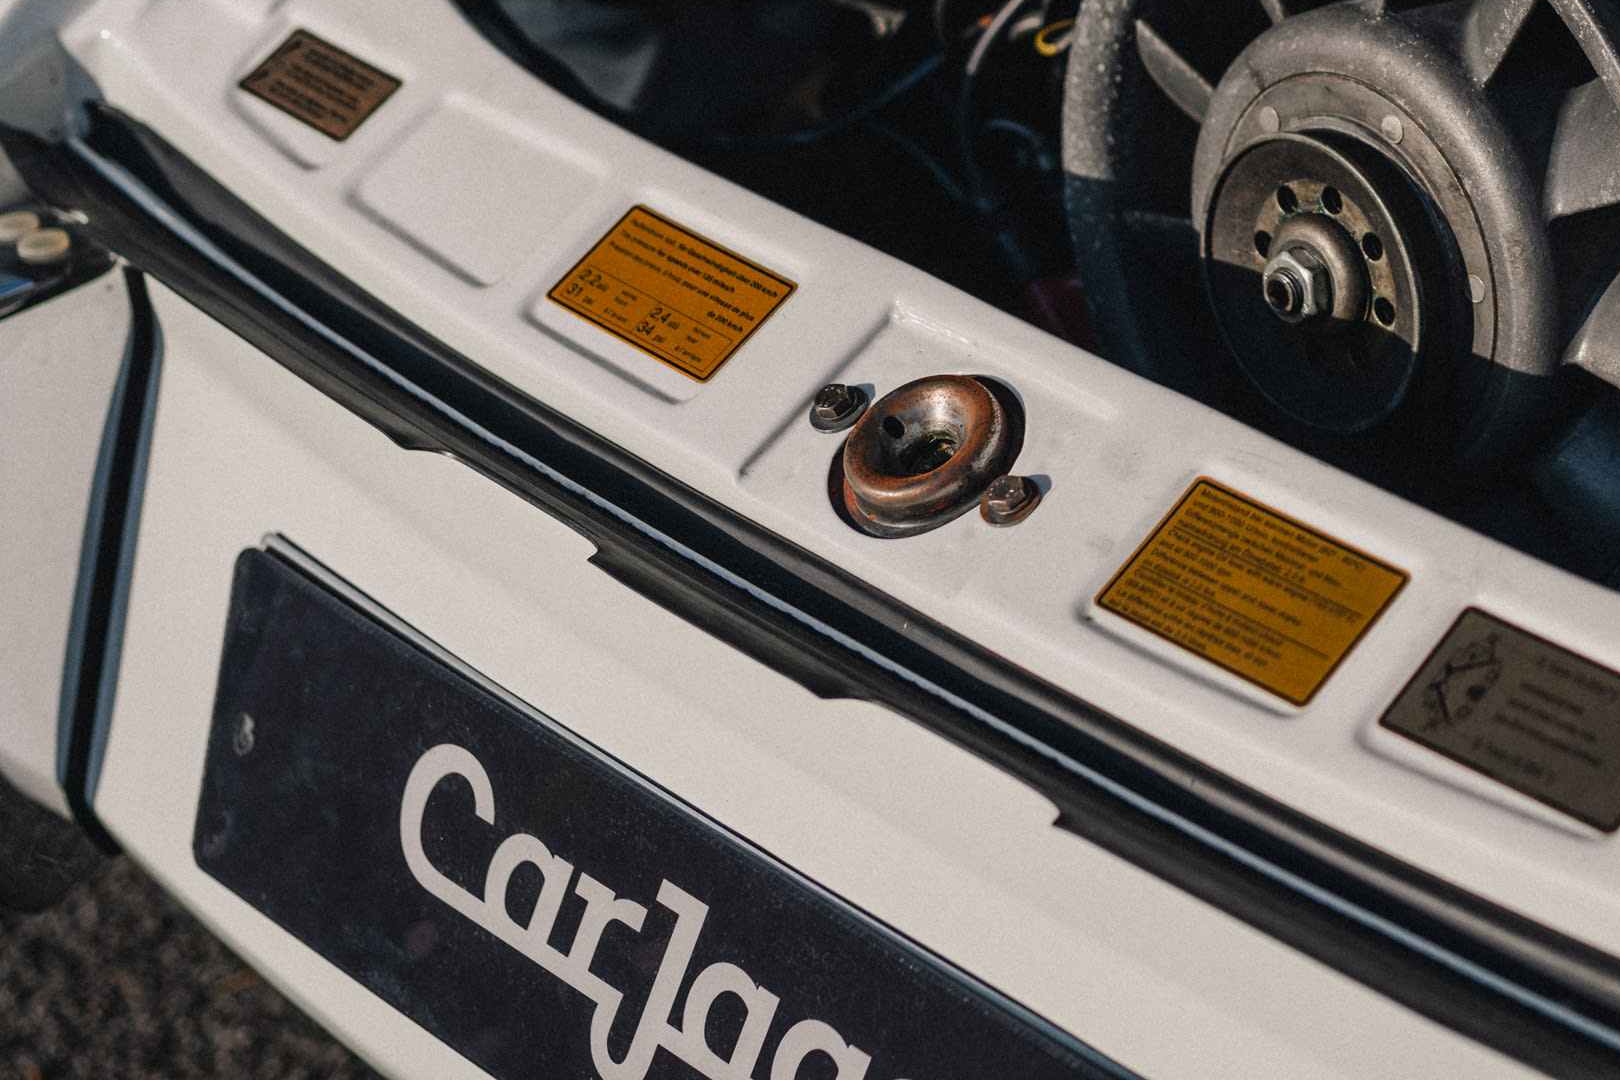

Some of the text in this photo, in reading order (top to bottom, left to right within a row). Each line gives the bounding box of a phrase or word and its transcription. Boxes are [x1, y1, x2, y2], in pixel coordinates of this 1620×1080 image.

[566, 283, 584, 296] 31
[649, 307, 671, 323] 2,4
[637, 321, 655, 335] 34
